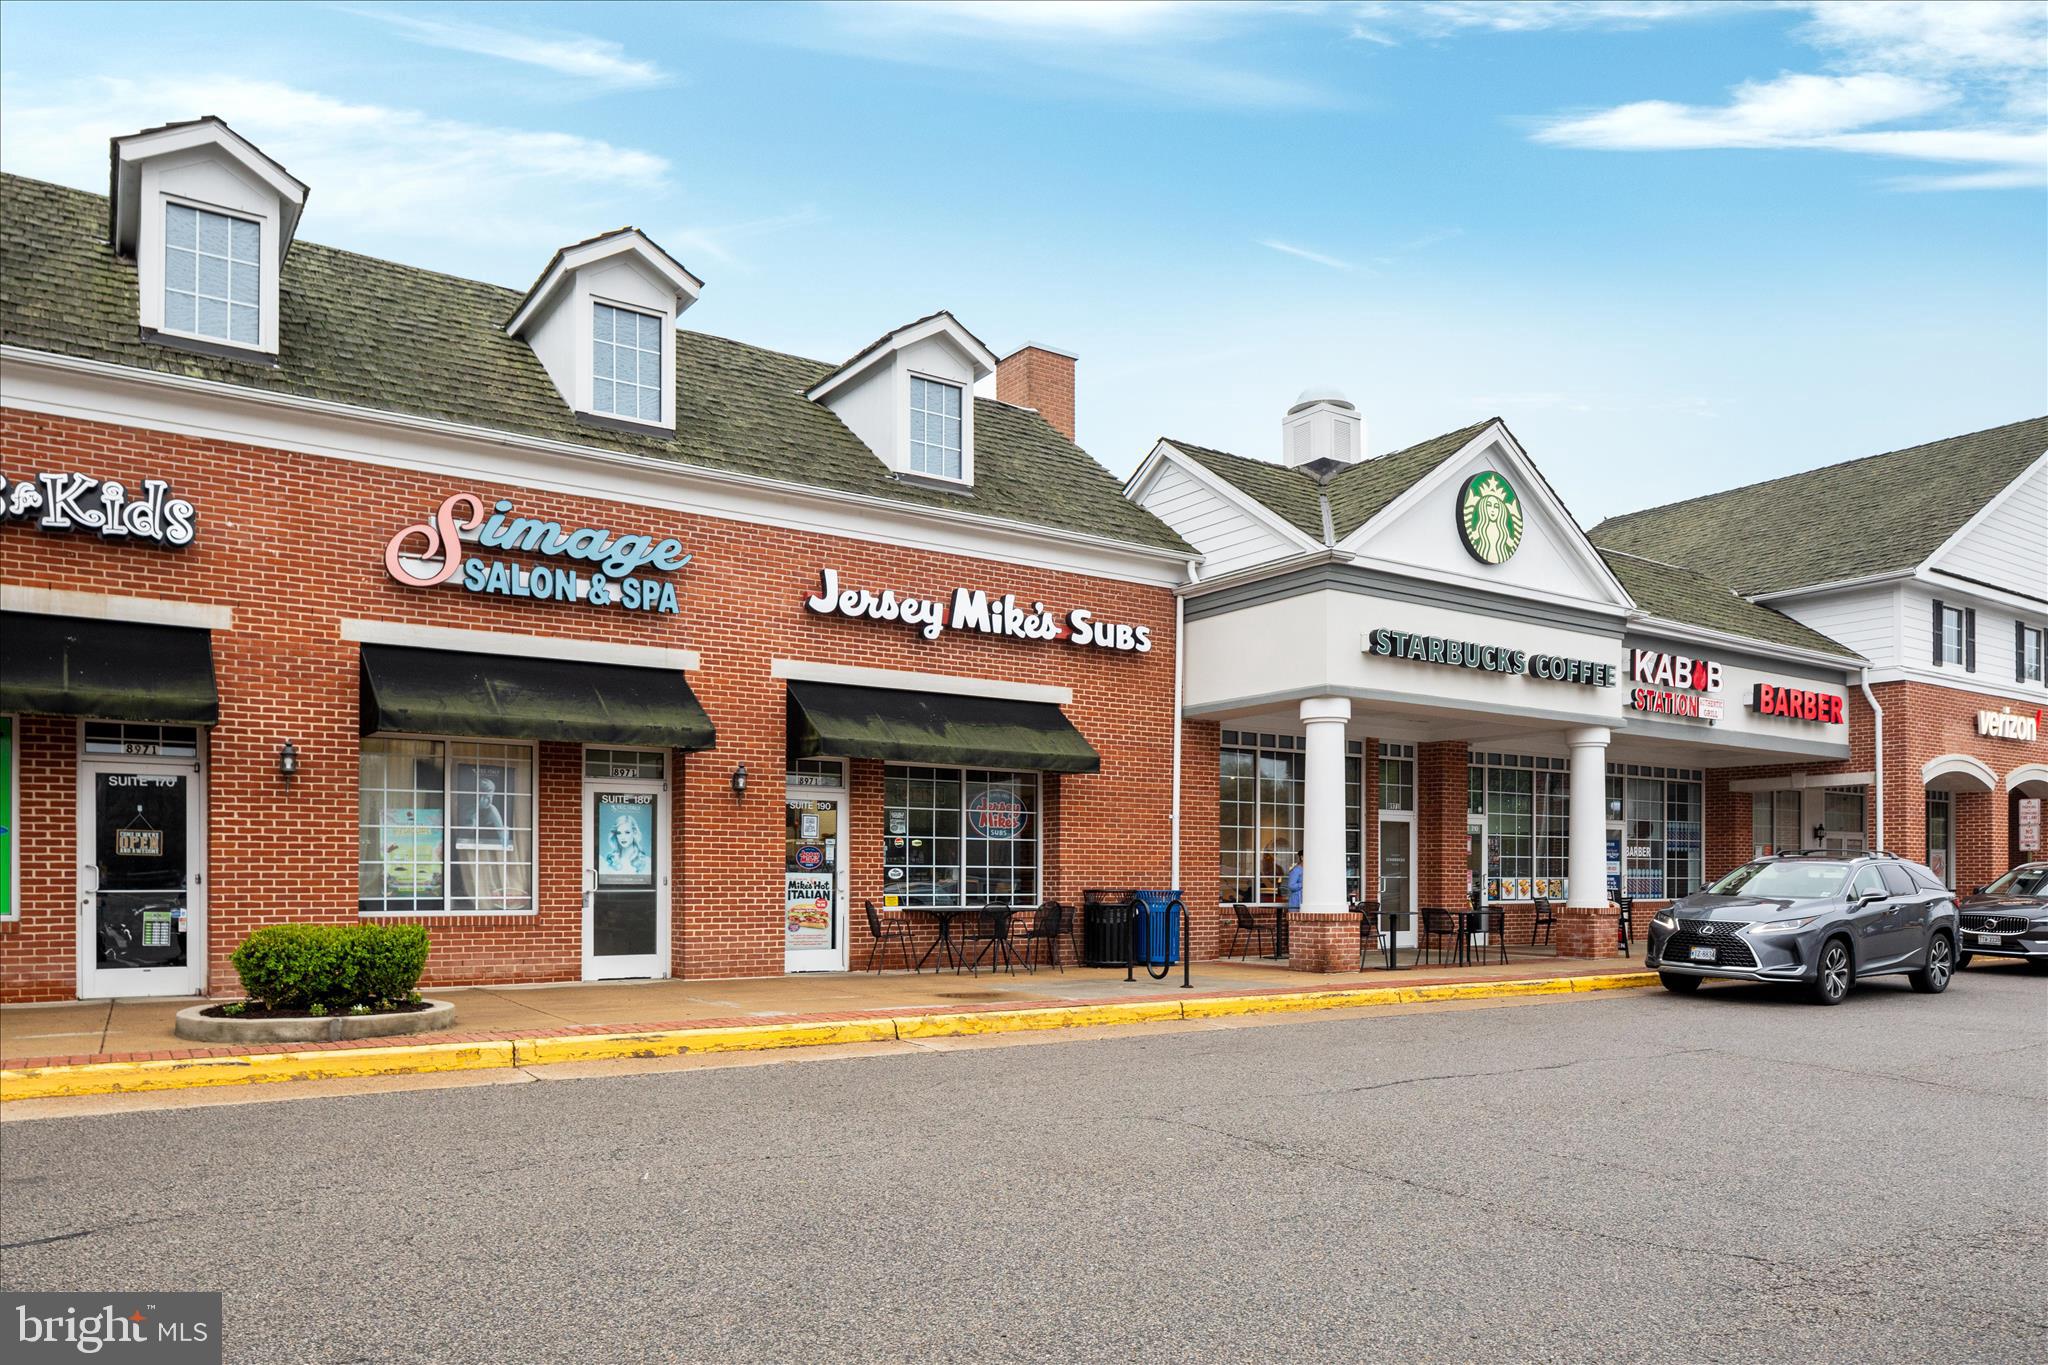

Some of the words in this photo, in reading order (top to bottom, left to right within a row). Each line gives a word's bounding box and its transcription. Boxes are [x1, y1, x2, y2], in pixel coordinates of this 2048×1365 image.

[9, 481, 43, 515] for
[39, 472, 195, 545] Kids
[463, 558, 578, 602] SALON
[587, 573, 613, 606] &
[620, 577, 680, 614] SPA
[808, 568, 944, 640] Jersey
[951, 587, 1062, 640] Mike's
[1069, 609, 1152, 652] SUBS
[1373, 627, 1527, 675] STARBUCKS
[1531, 652, 1617, 688] COFFEE
[1634, 687, 1700, 717] STATION
[1758, 683, 1845, 724] BARBER
[1976, 706, 2037, 742] verizon
[126, 744, 157, 755] 8971
[613, 768, 637, 778] 8971
[108, 776, 149, 787] SUITE
[155, 776, 176, 788] 170
[800, 776, 818, 785] 8971
[601, 794, 630, 804] SUITE
[634, 795, 651, 804] 180
[789, 800, 814, 810] SUITE
[816, 802, 831, 811] 190
[975, 797, 1021, 818] Jersey
[119, 836, 159, 849] OPEN
[1625, 846, 1651, 857] BARBER
[788, 880, 813, 890] Mike's
[814, 880, 830, 890] Hot
[787, 889, 831, 901] ITALIAN
